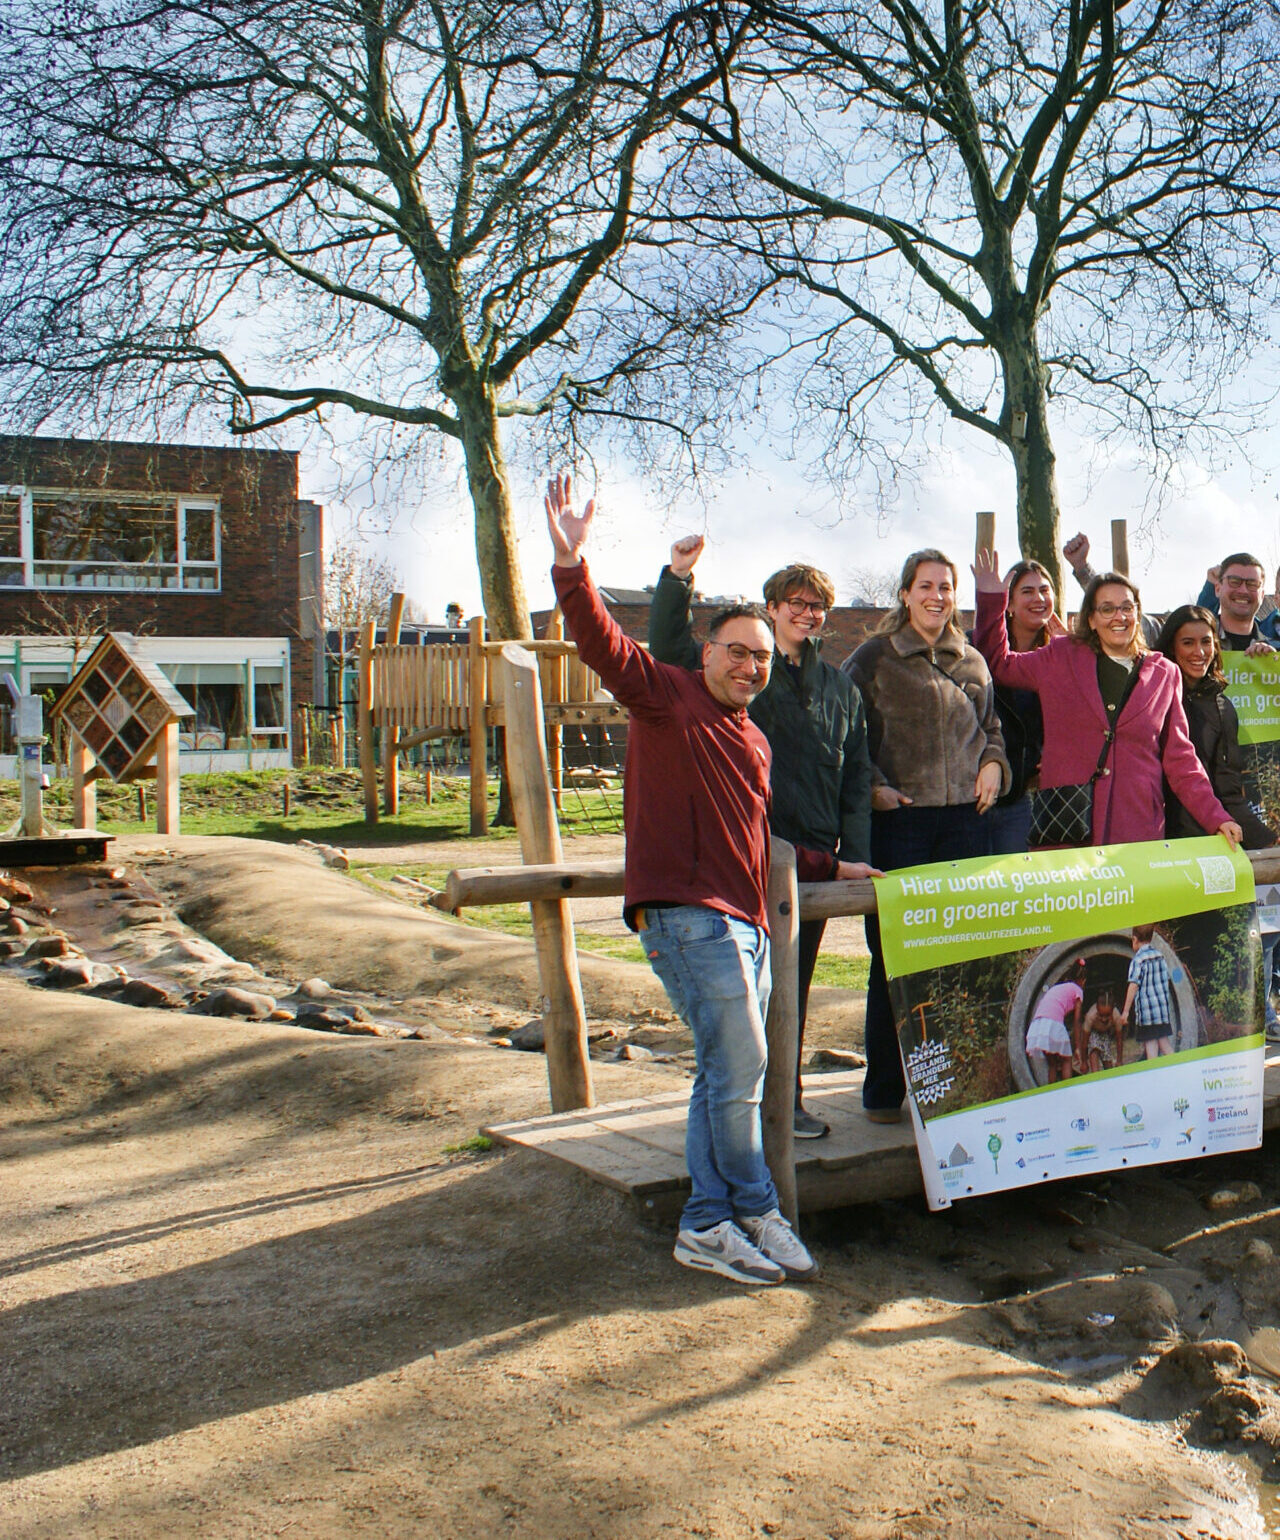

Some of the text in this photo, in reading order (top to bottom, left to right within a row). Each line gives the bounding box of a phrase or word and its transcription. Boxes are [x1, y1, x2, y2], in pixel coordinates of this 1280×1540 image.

[900, 864, 1126, 896] Hier wordt gewerkt aan
[903, 884, 1135, 929] een groener schoolplein!
[903, 925, 1054, 949] WWW.GROENEREVOLUTIEZEELAND.NL
[911, 1060, 952, 1084] ERANDERT
[1216, 1108, 1249, 1120] Zeeland
